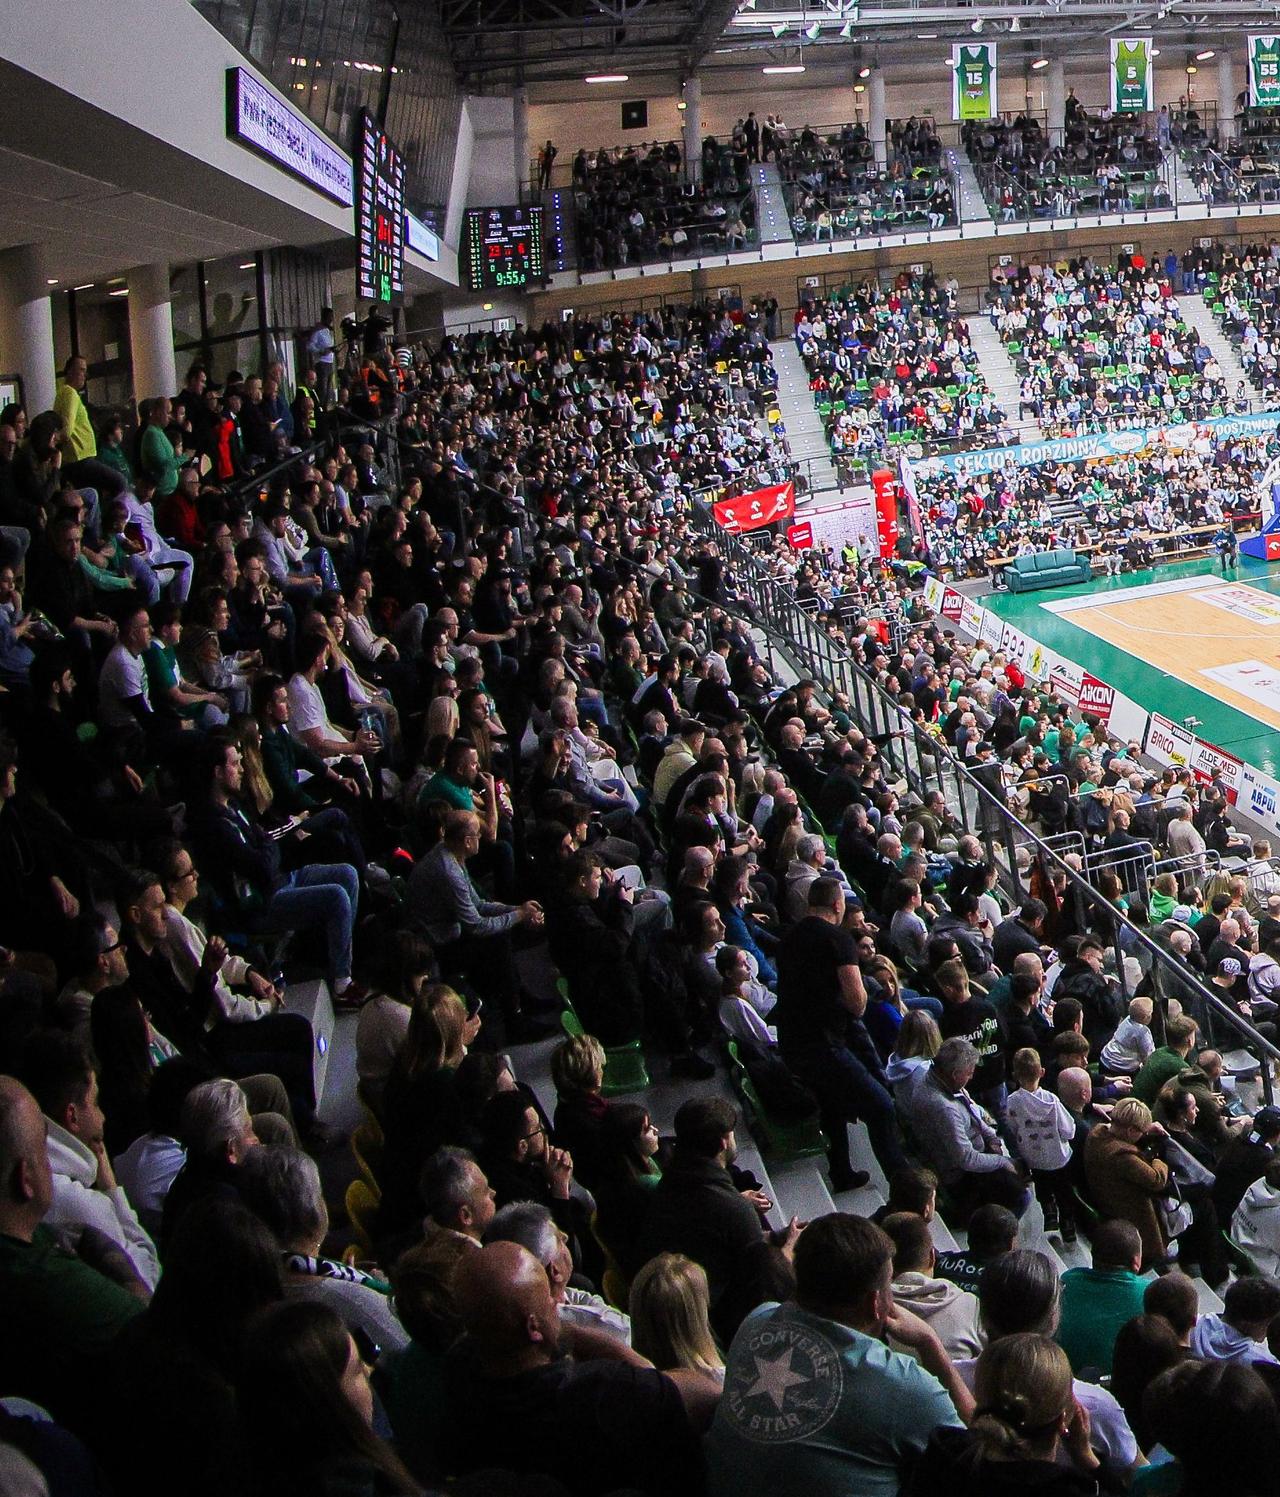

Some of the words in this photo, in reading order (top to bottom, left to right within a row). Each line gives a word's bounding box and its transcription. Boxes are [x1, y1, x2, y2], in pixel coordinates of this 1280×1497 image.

[966, 72, 982, 85] 15
[1127, 67, 1136, 79] 5
[1260, 63, 1278, 76] 55
[954, 449, 1013, 475] SEKTOR
[1021, 436, 1100, 467] RODZINNY
[1080, 684, 1112, 705] AiKON
[1151, 730, 1174, 755] BRICO
[1251, 789, 1276, 815] ARPOL
[750, 1331, 830, 1378] CONVERSE
[750, 1413, 801, 1432] STAR
